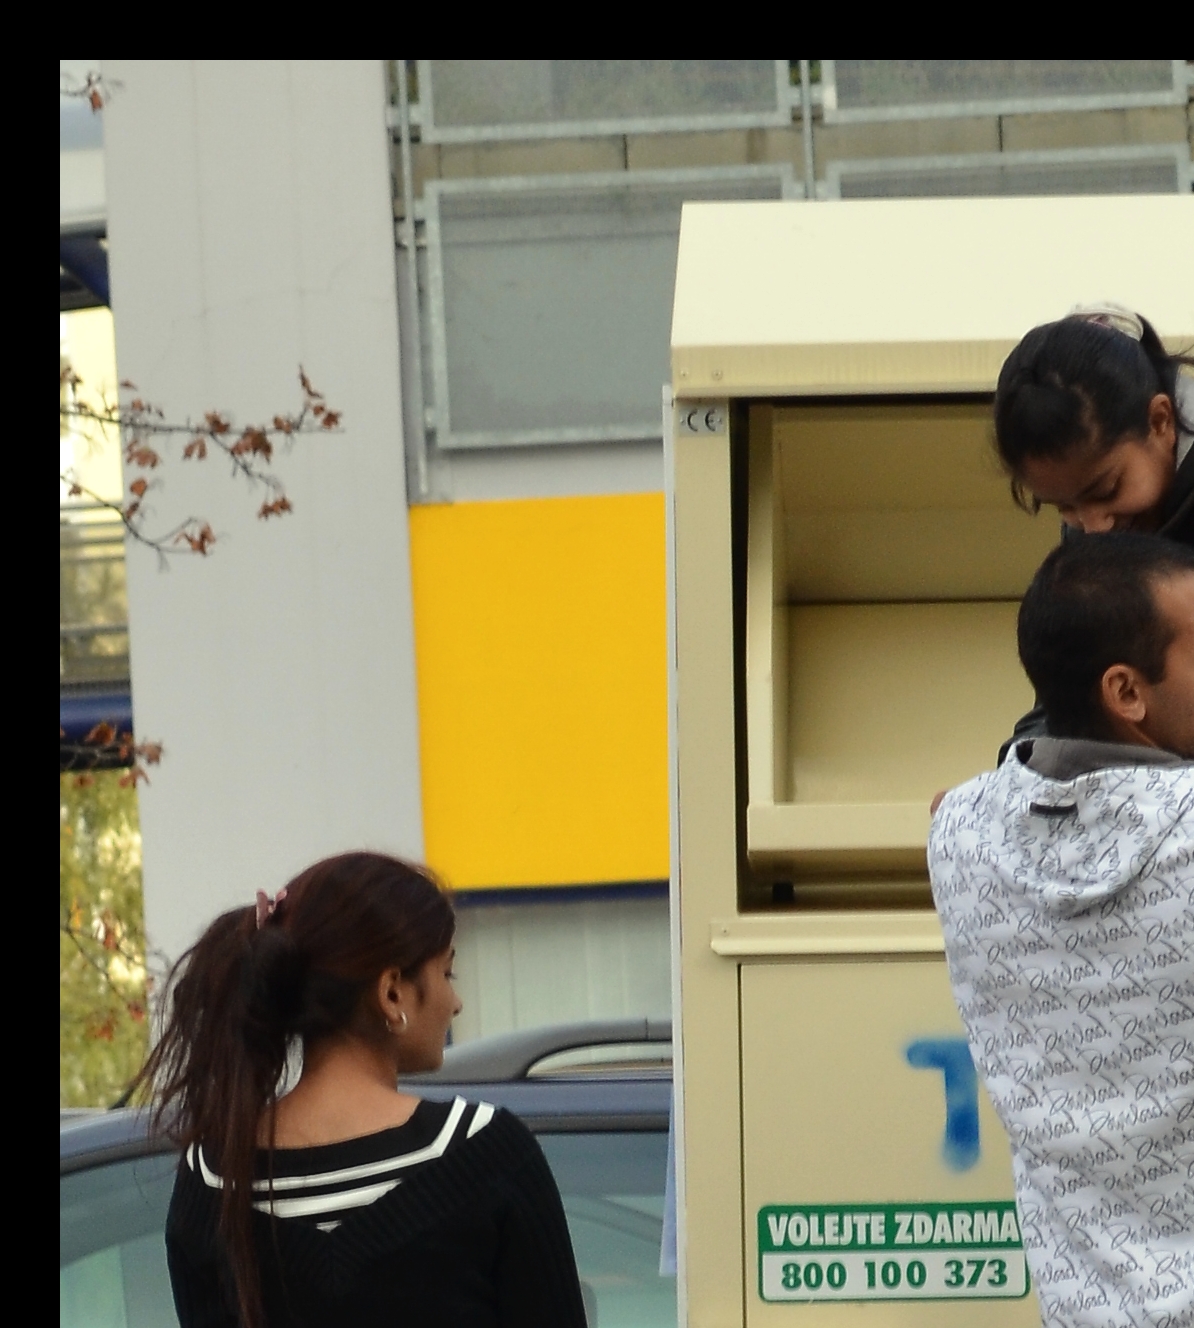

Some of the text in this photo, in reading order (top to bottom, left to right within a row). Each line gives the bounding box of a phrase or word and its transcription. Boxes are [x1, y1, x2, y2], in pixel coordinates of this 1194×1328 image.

[767, 1209, 1020, 1247] VOLEJTE ZDARMA
[781, 1259, 1008, 1290] 800 100 373
